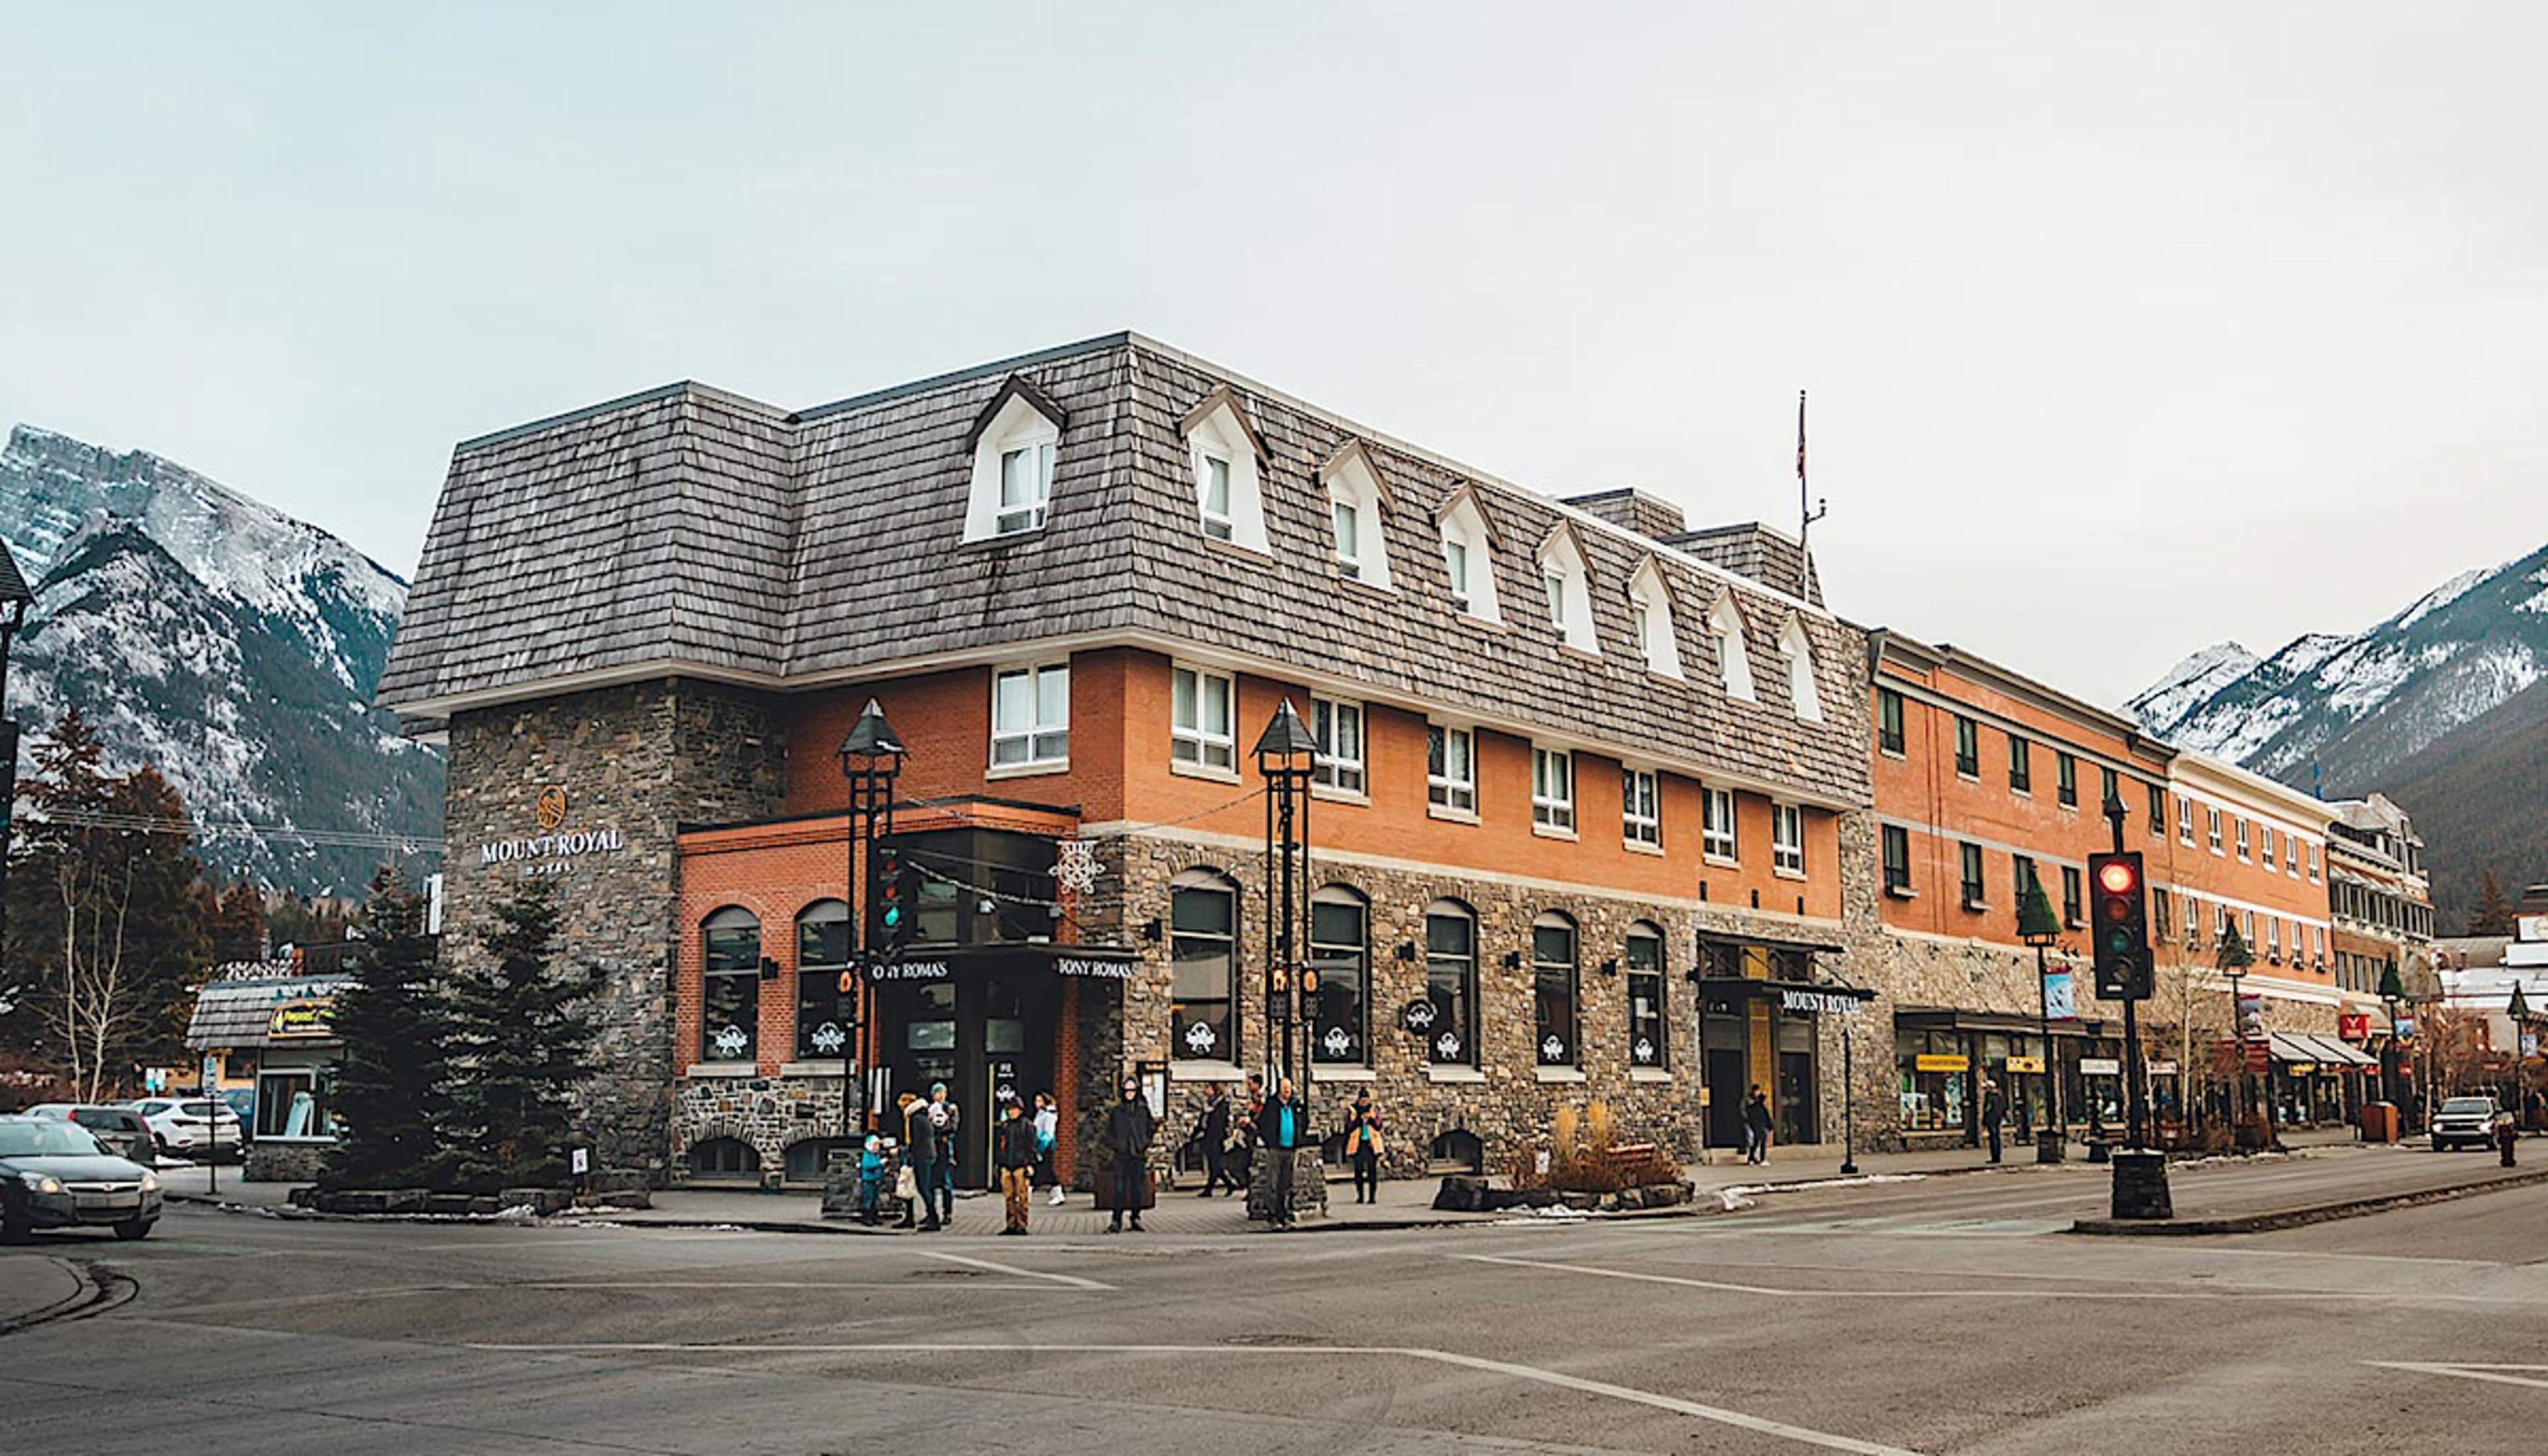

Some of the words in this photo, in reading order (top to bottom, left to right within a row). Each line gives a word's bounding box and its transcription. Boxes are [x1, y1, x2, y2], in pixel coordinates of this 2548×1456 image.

[481, 836, 554, 863] MOUNT
[557, 829, 623, 856] ROYAL
[870, 964, 900, 980] OY
[1058, 958, 1092, 975] TONY
[1782, 990, 1824, 1012] MOUNT
[1825, 994, 1861, 1014] ROYAL
